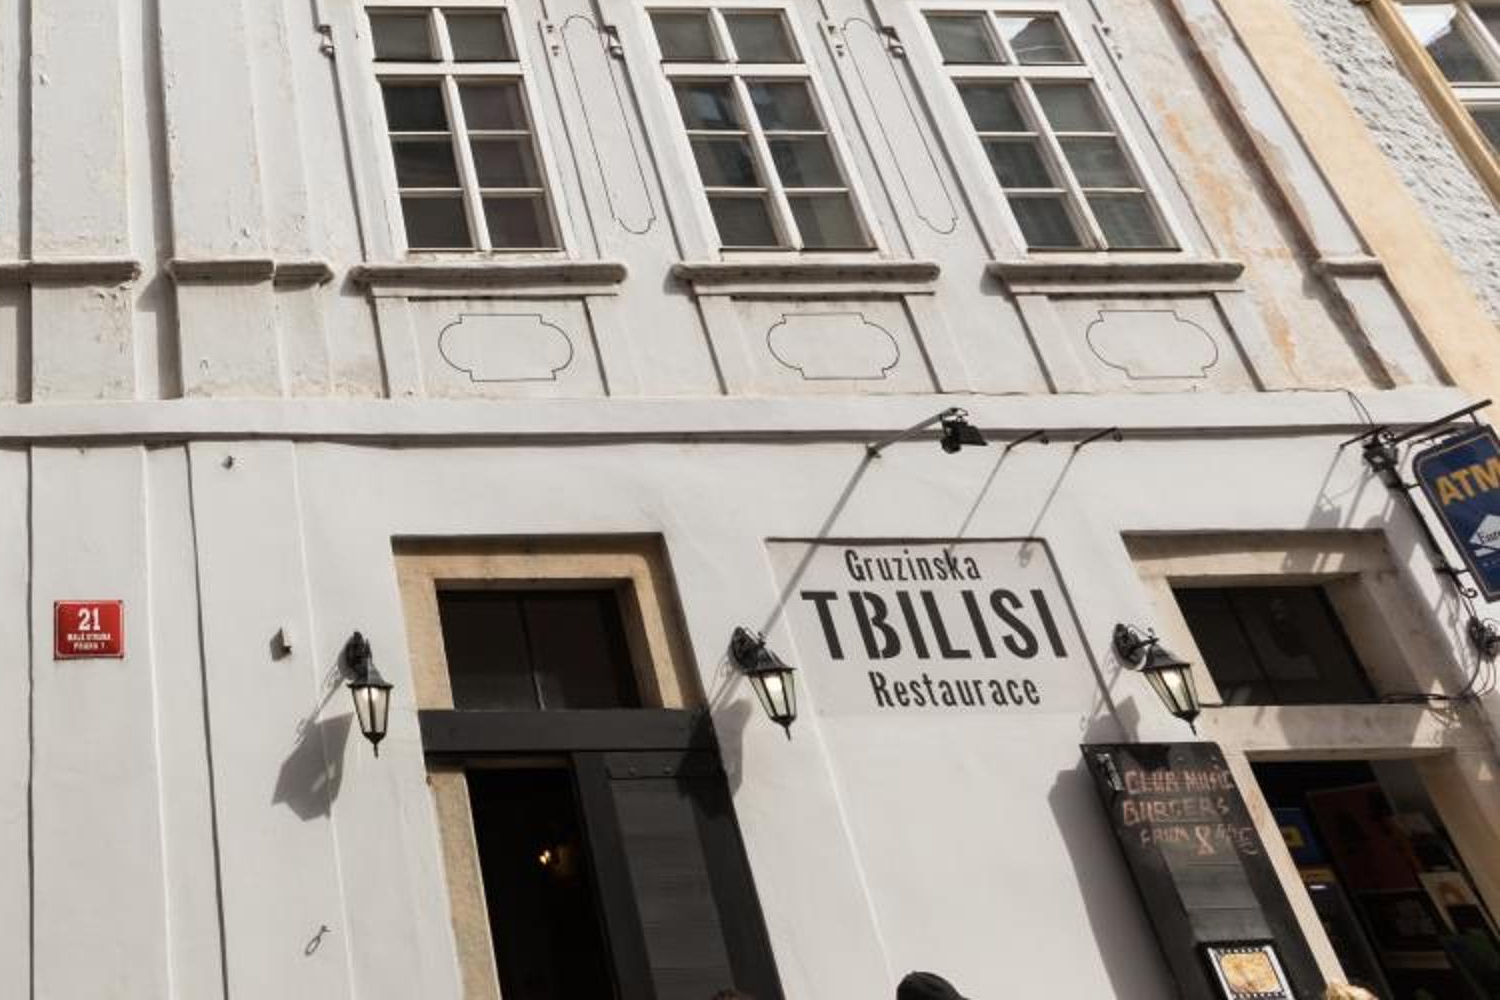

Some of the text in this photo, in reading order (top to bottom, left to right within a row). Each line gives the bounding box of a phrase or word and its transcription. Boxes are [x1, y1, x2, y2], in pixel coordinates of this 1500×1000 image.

[77, 607, 101, 631] 21
[800, 588, 1068, 660] TBILISI
[868, 670, 1041, 707] Restaurace
